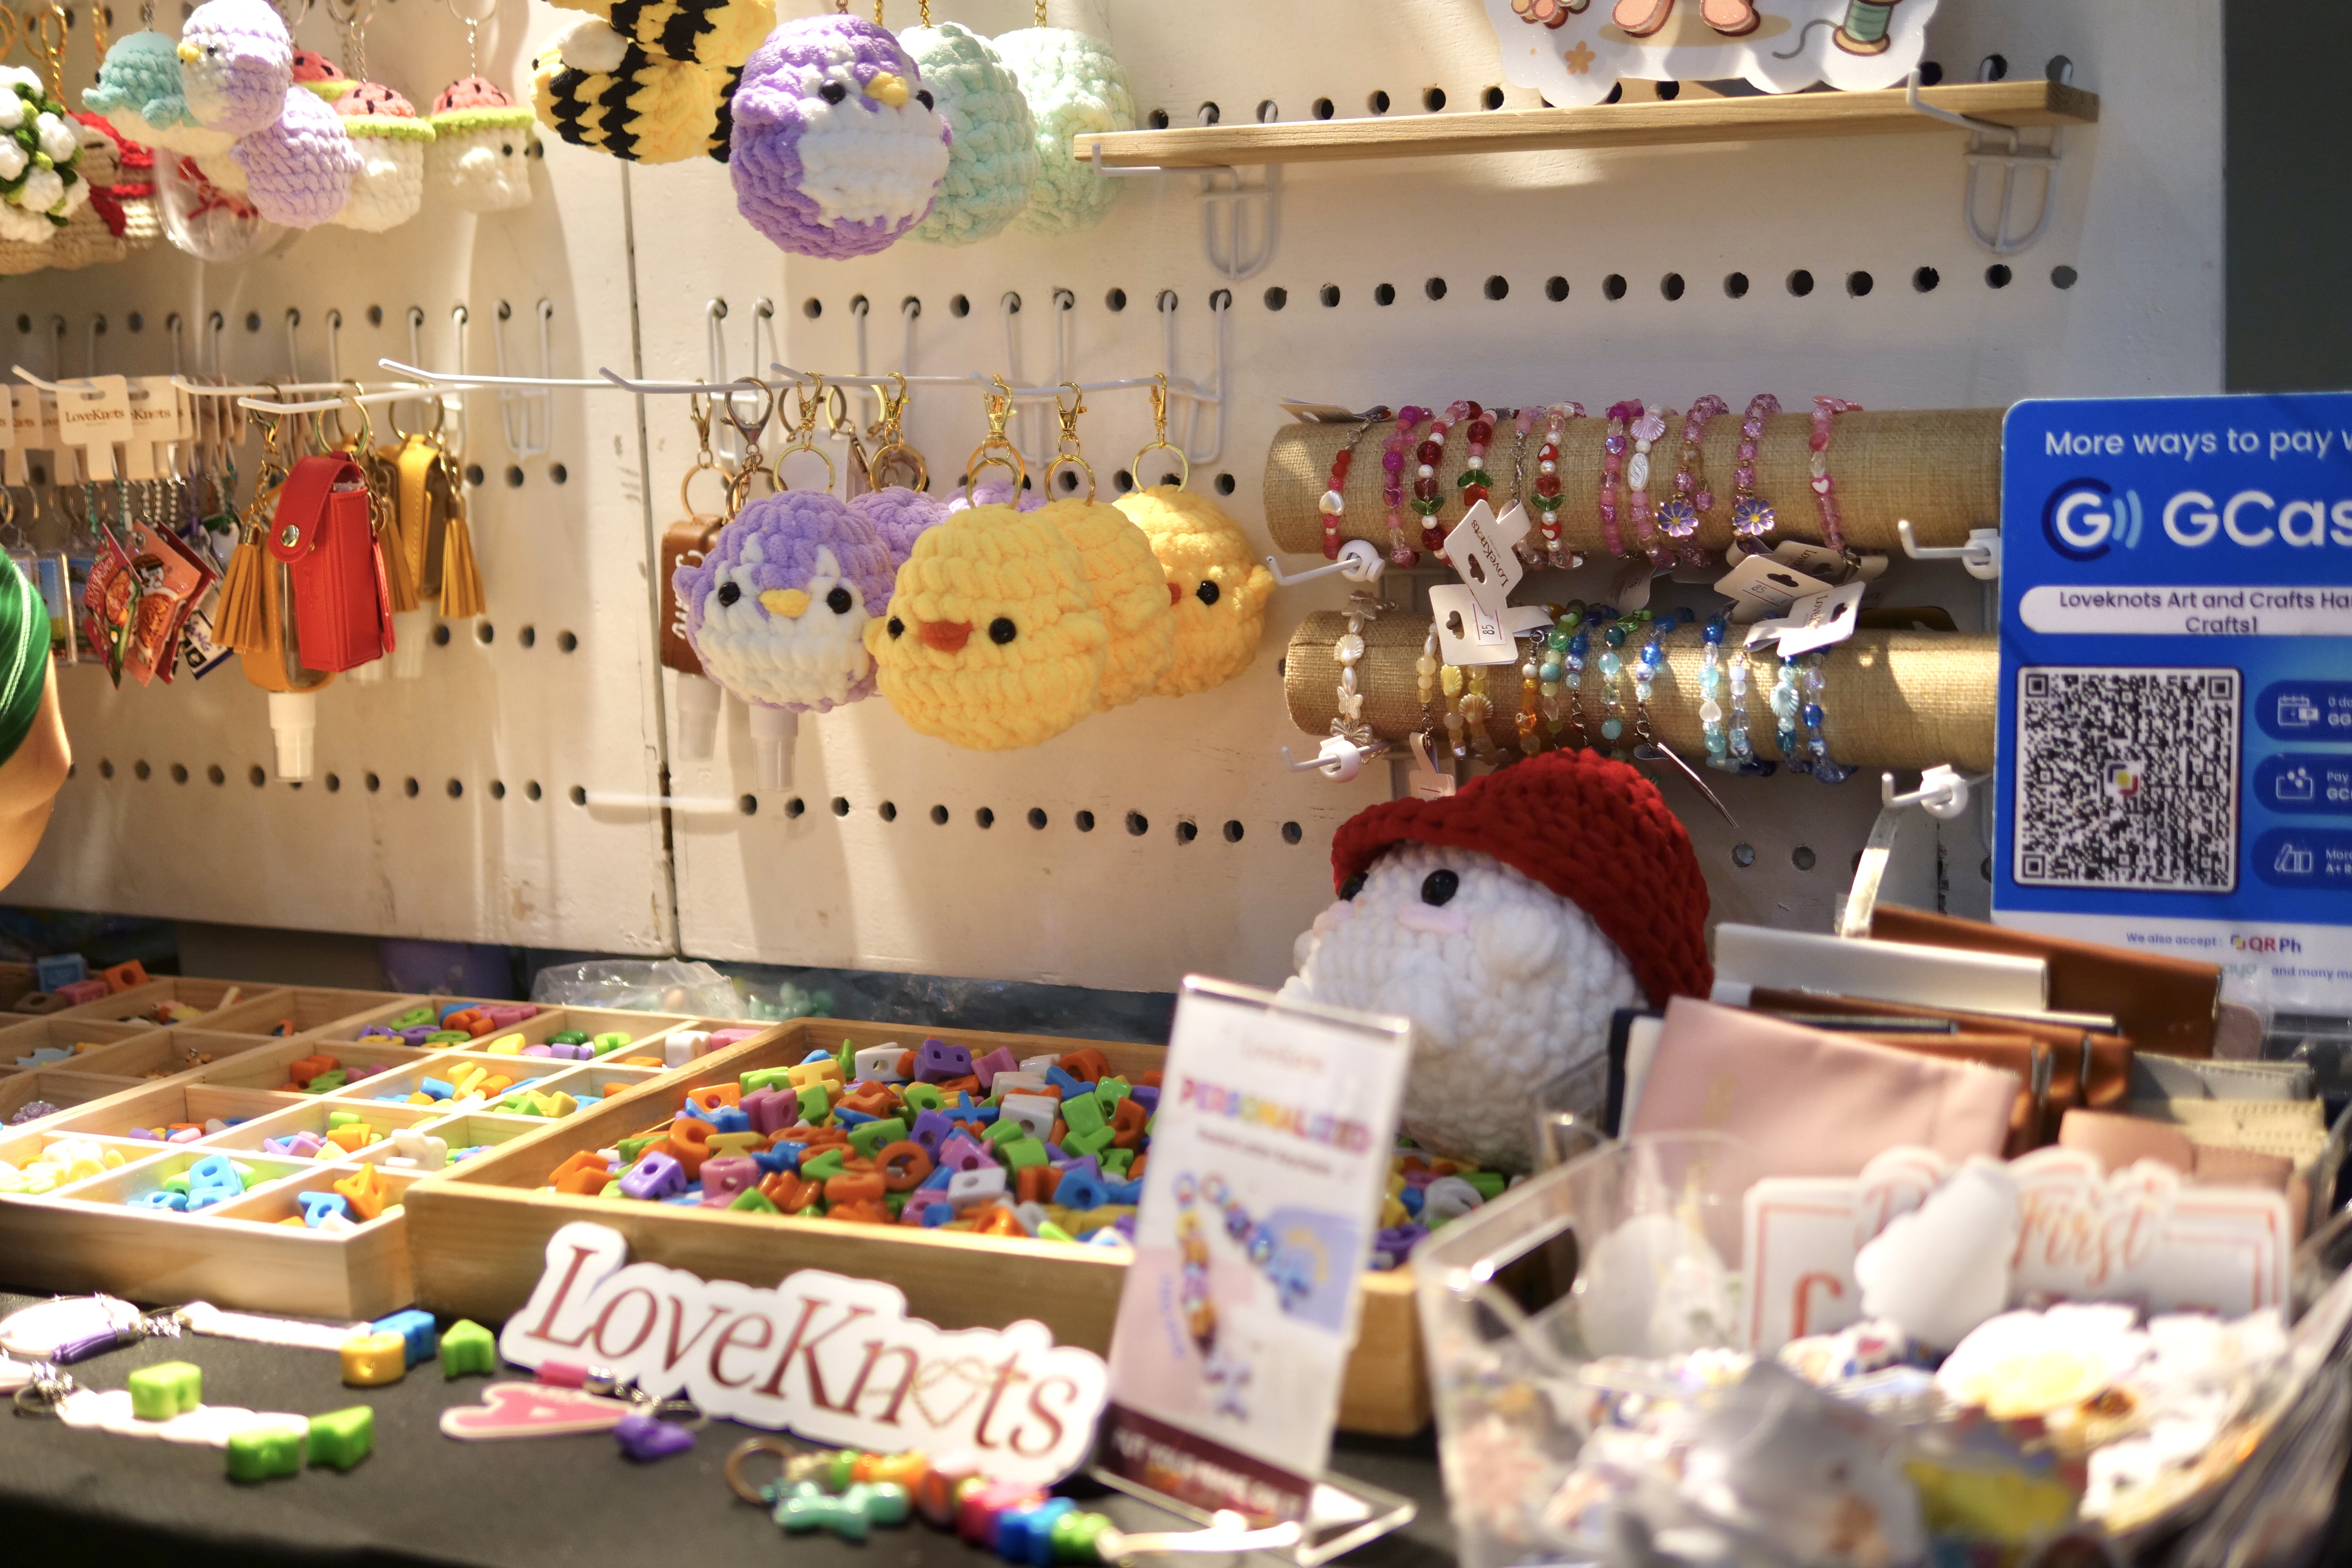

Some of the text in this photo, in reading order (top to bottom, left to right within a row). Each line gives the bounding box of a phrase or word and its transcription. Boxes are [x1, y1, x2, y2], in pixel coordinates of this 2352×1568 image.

[2045, 431, 2123, 455] More
[2133, 432, 2216, 461] ways
[2227, 429, 2260, 453] to
[2270, 430, 2332, 460] pay
[1470, 519, 1509, 588] LoveKnots
[1789, 549, 1818, 568] LoveK
[1751, 584, 1767, 593] 85
[2060, 591, 2161, 608] Loveknots
[2167, 592, 2197, 608] Art
[2202, 591, 2244, 608] and
[2249, 590, 2314, 608] Crafts
[1481, 624, 1495, 635] 85
[2127, 932, 2145, 943] We
[2148, 933, 2172, 944] also
[2175, 935, 2217, 948] accept
[2249, 936, 2302, 954] QR Ph
[2271, 967, 2296, 977] and
[2298, 968, 2334, 981] many
[524, 1244, 1080, 1458] LoveKnots
